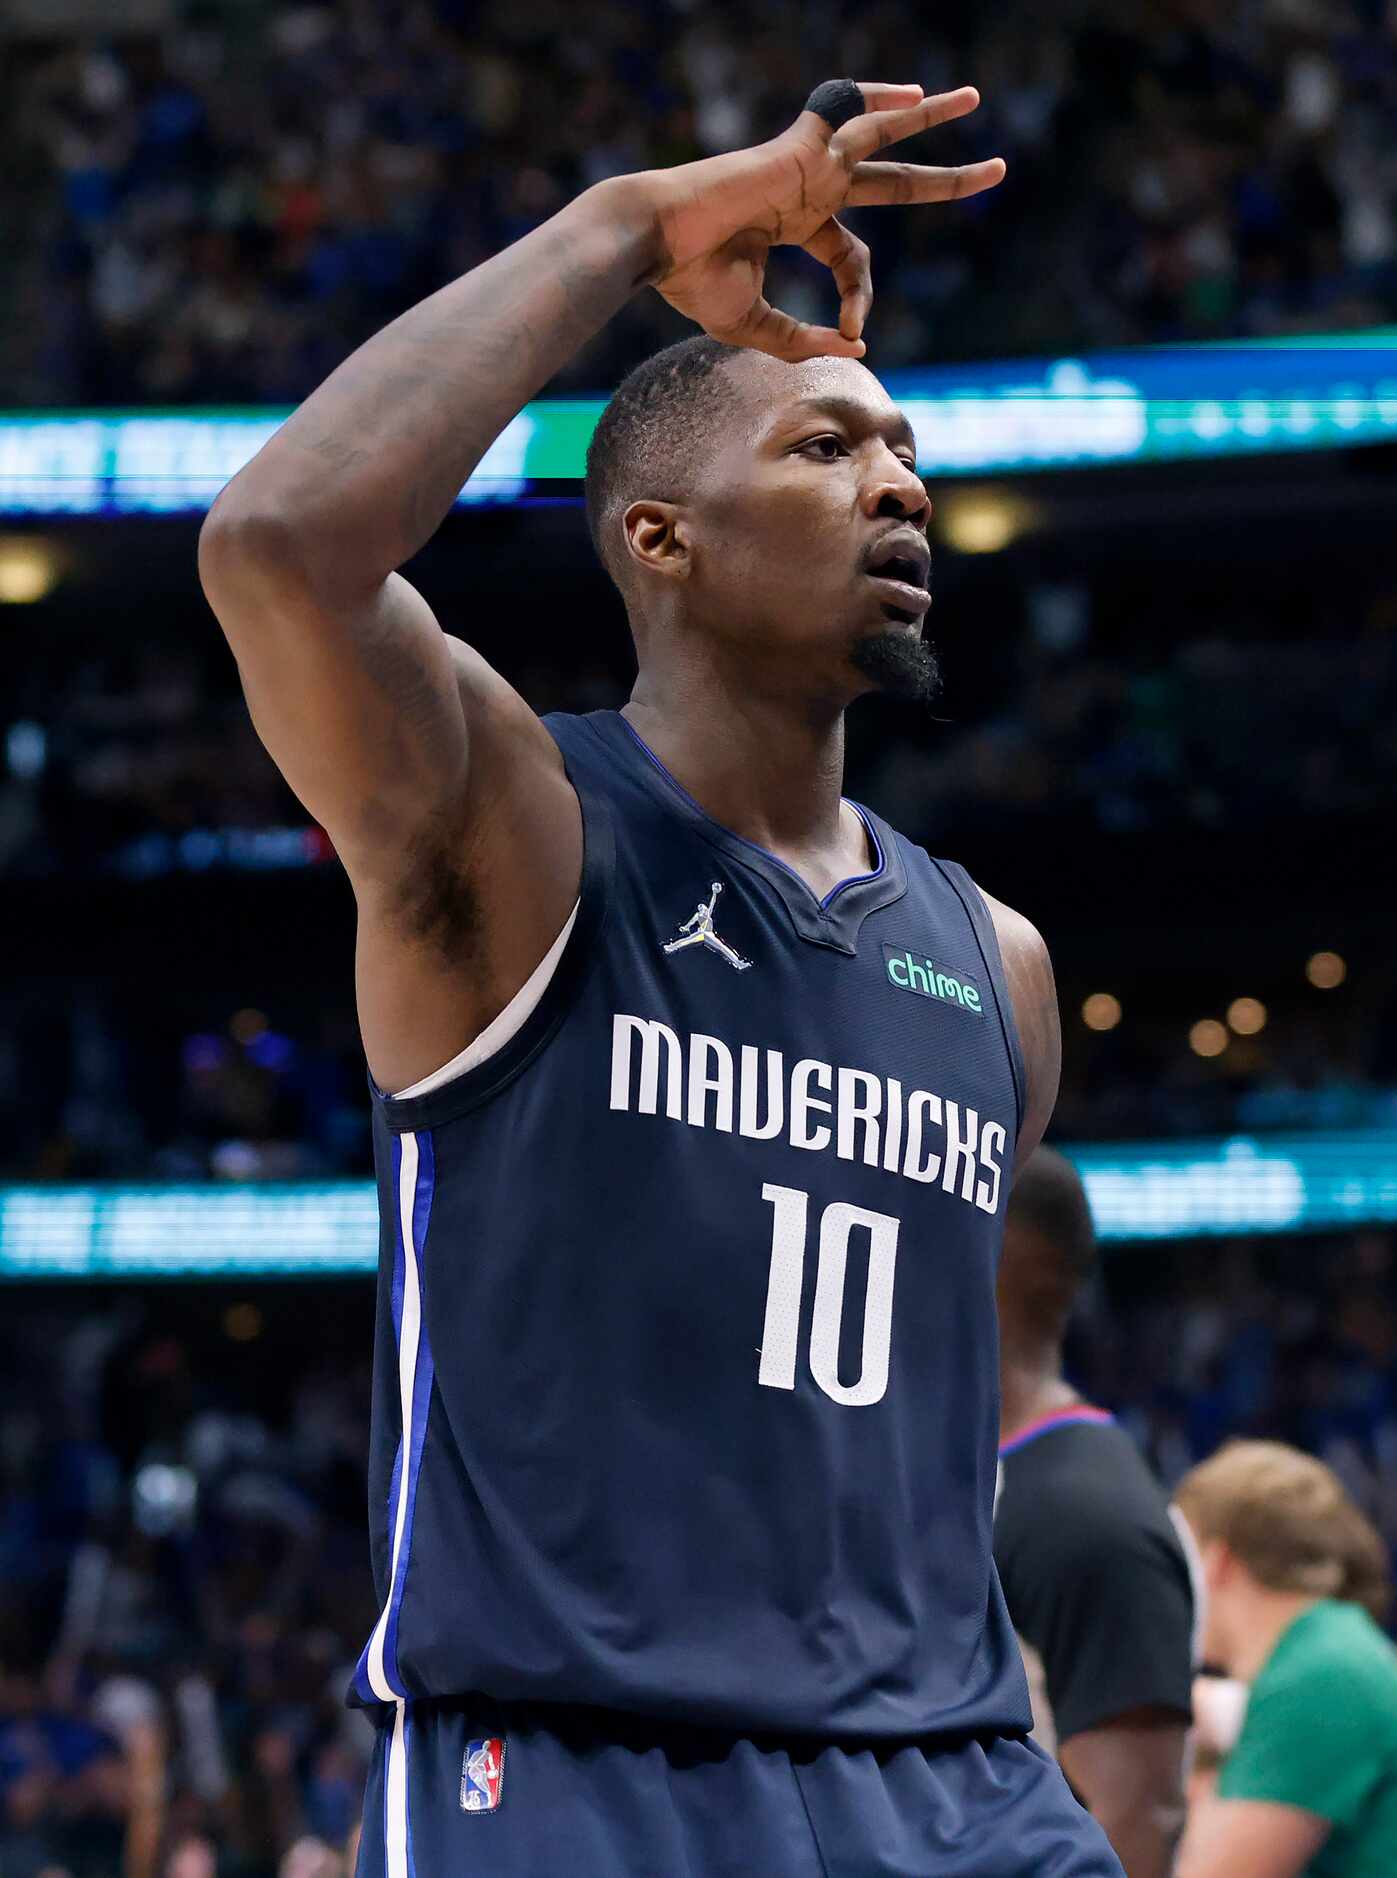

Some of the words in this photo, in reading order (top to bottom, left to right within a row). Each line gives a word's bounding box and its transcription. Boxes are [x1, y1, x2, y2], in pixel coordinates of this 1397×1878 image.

[887, 952, 982, 1014] chime
[609, 1013, 1006, 1215] MAVERICKS
[758, 1183, 901, 1407] 10
